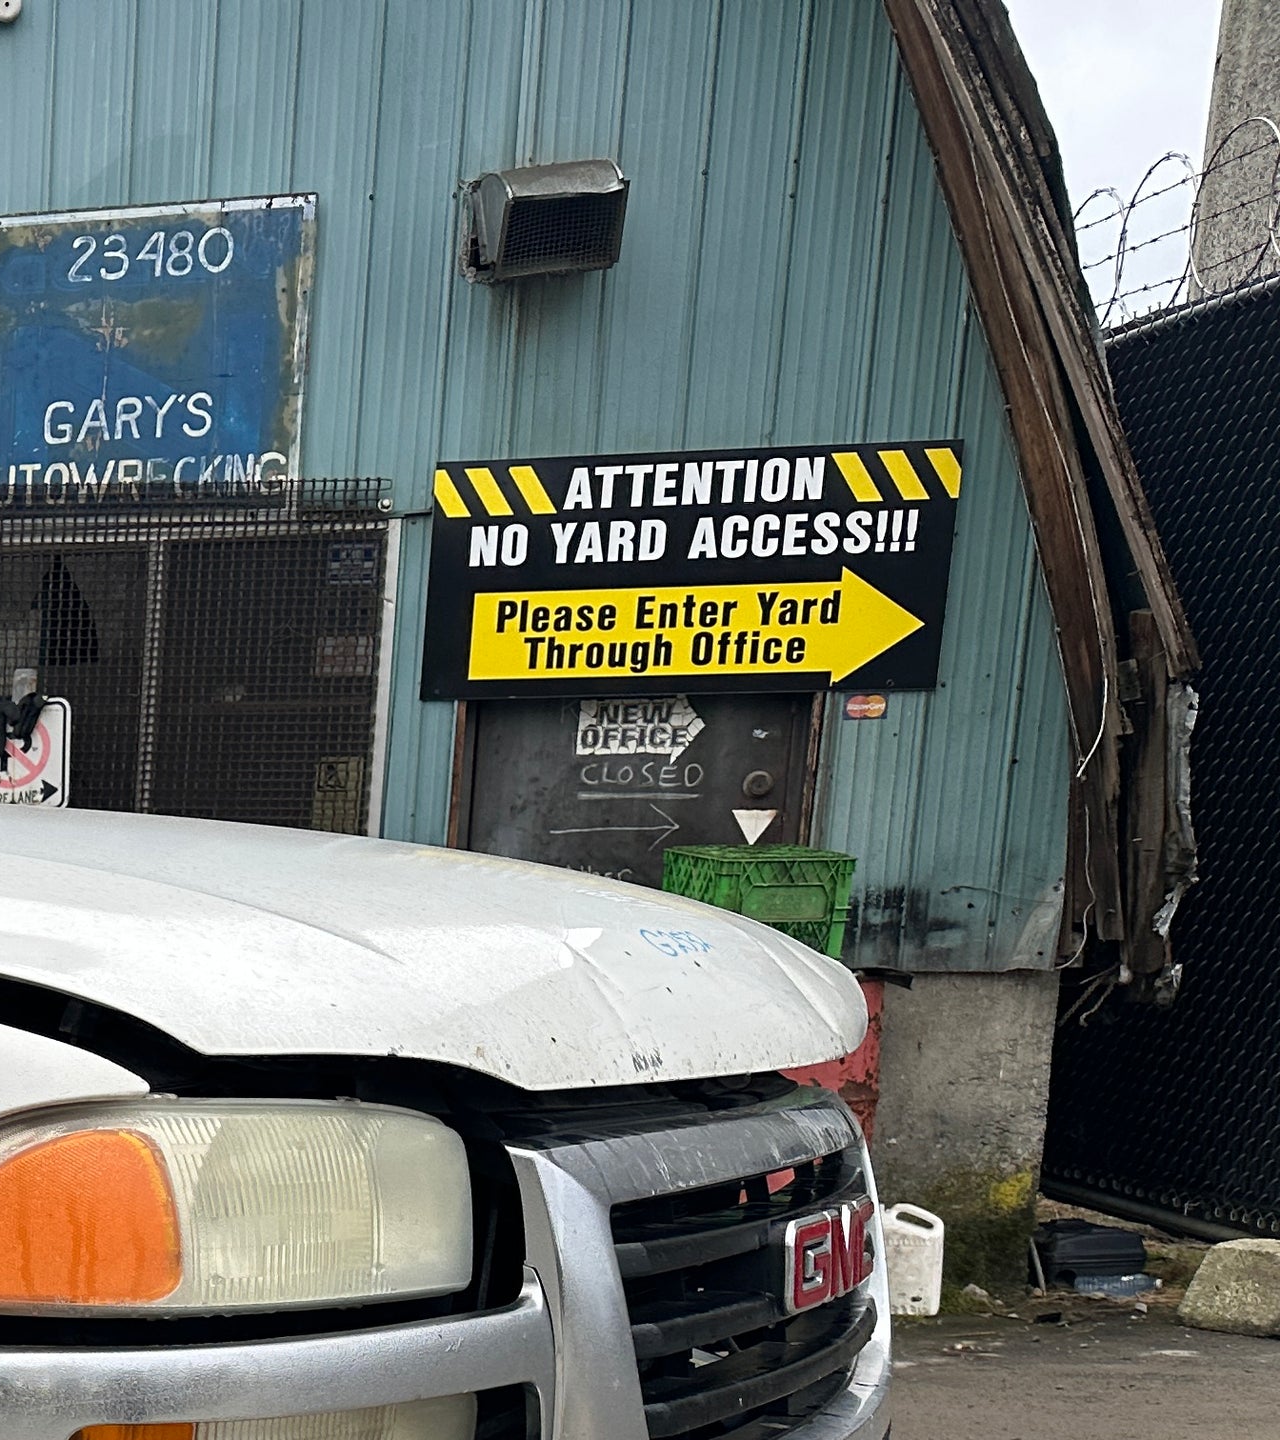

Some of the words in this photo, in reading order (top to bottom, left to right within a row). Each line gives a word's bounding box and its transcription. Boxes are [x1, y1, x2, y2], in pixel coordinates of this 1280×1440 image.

[67, 226, 235, 283] 23480
[44, 391, 214, 445] GARY'S
[562, 456, 826, 511] ATTENTION
[468, 524, 530, 568] NO
[550, 518, 667, 565] YARD
[687, 509, 920, 561] ACCESS!!!
[496, 599, 616, 634] Please
[635, 594, 738, 630] Enter
[757, 589, 841, 626] Yard
[524, 633, 673, 674] Through
[691, 632, 807, 666] Office
[580, 724, 688, 749] OFFICE
[598, 703, 672, 725] NEW
[581, 761, 704, 787] CLOSED
